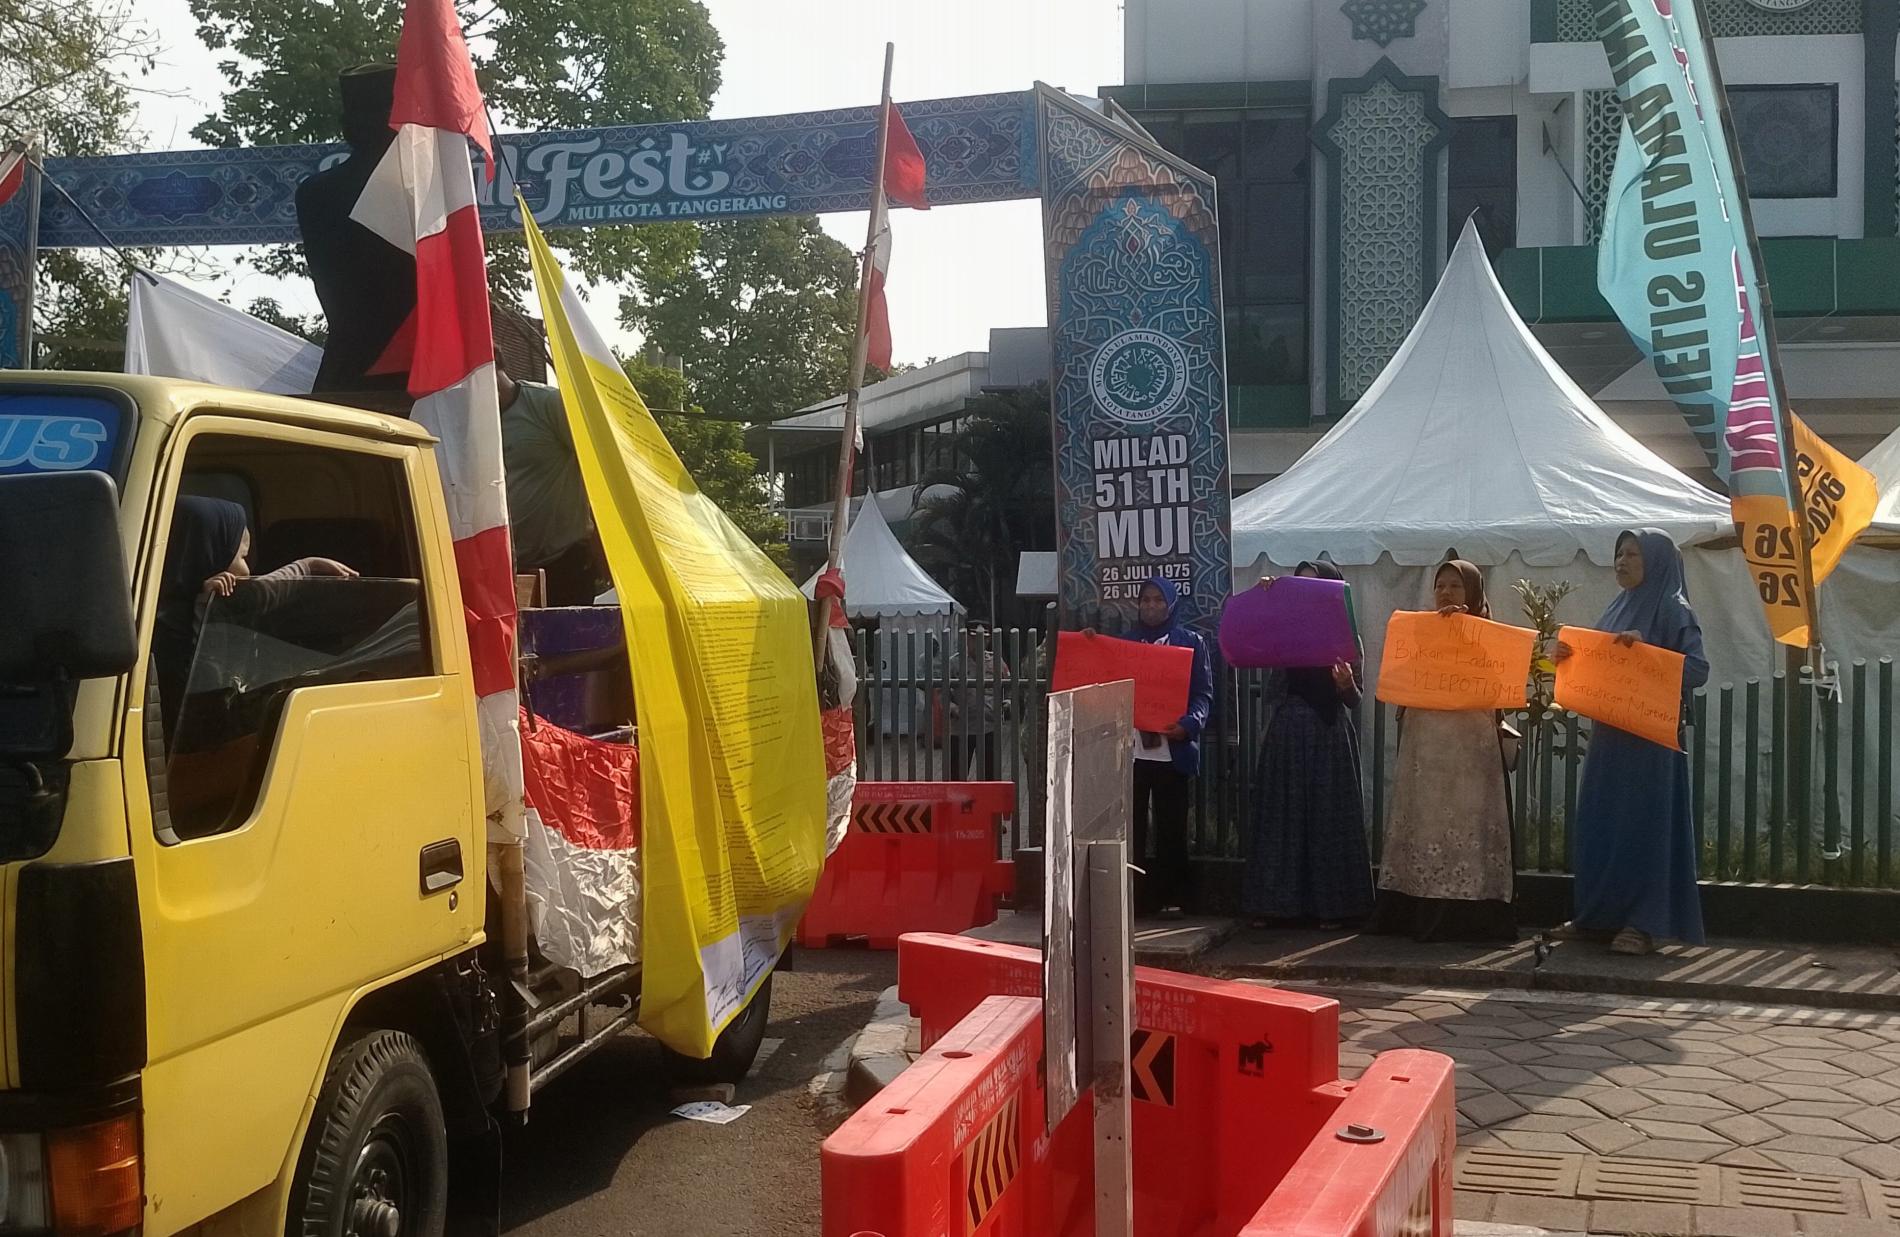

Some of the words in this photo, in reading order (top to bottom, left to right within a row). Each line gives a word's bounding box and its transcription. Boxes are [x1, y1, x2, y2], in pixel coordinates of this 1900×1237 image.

[511, 132, 729, 224] Fest
[568, 206, 607, 221] MUI
[608, 202, 663, 218] KOTA
[667, 195, 787, 215] TANGERANG
[1095, 346, 1114, 388] MAJELIS
[1114, 333, 1149, 348] ULAMA
[1151, 336, 1184, 381] INDONESIA
[1101, 396, 1123, 416] KOTA
[1125, 390, 1178, 419] TANGERANG
[1093, 434, 1188, 470] MILAD
[1095, 471, 1134, 508] 51
[1147, 467, 1190, 504] TH
[1097, 506, 1190, 559] MUI
[1102, 567, 1119, 582] 26
[1123, 565, 1153, 580] JULI
[1156, 563, 1190, 578] 1975
[1103, 585, 1120, 600] 26
[1448, 619, 1484, 648] MUI
[1394, 639, 1441, 661] Bukan
[1455, 647, 1506, 674] Ladang
